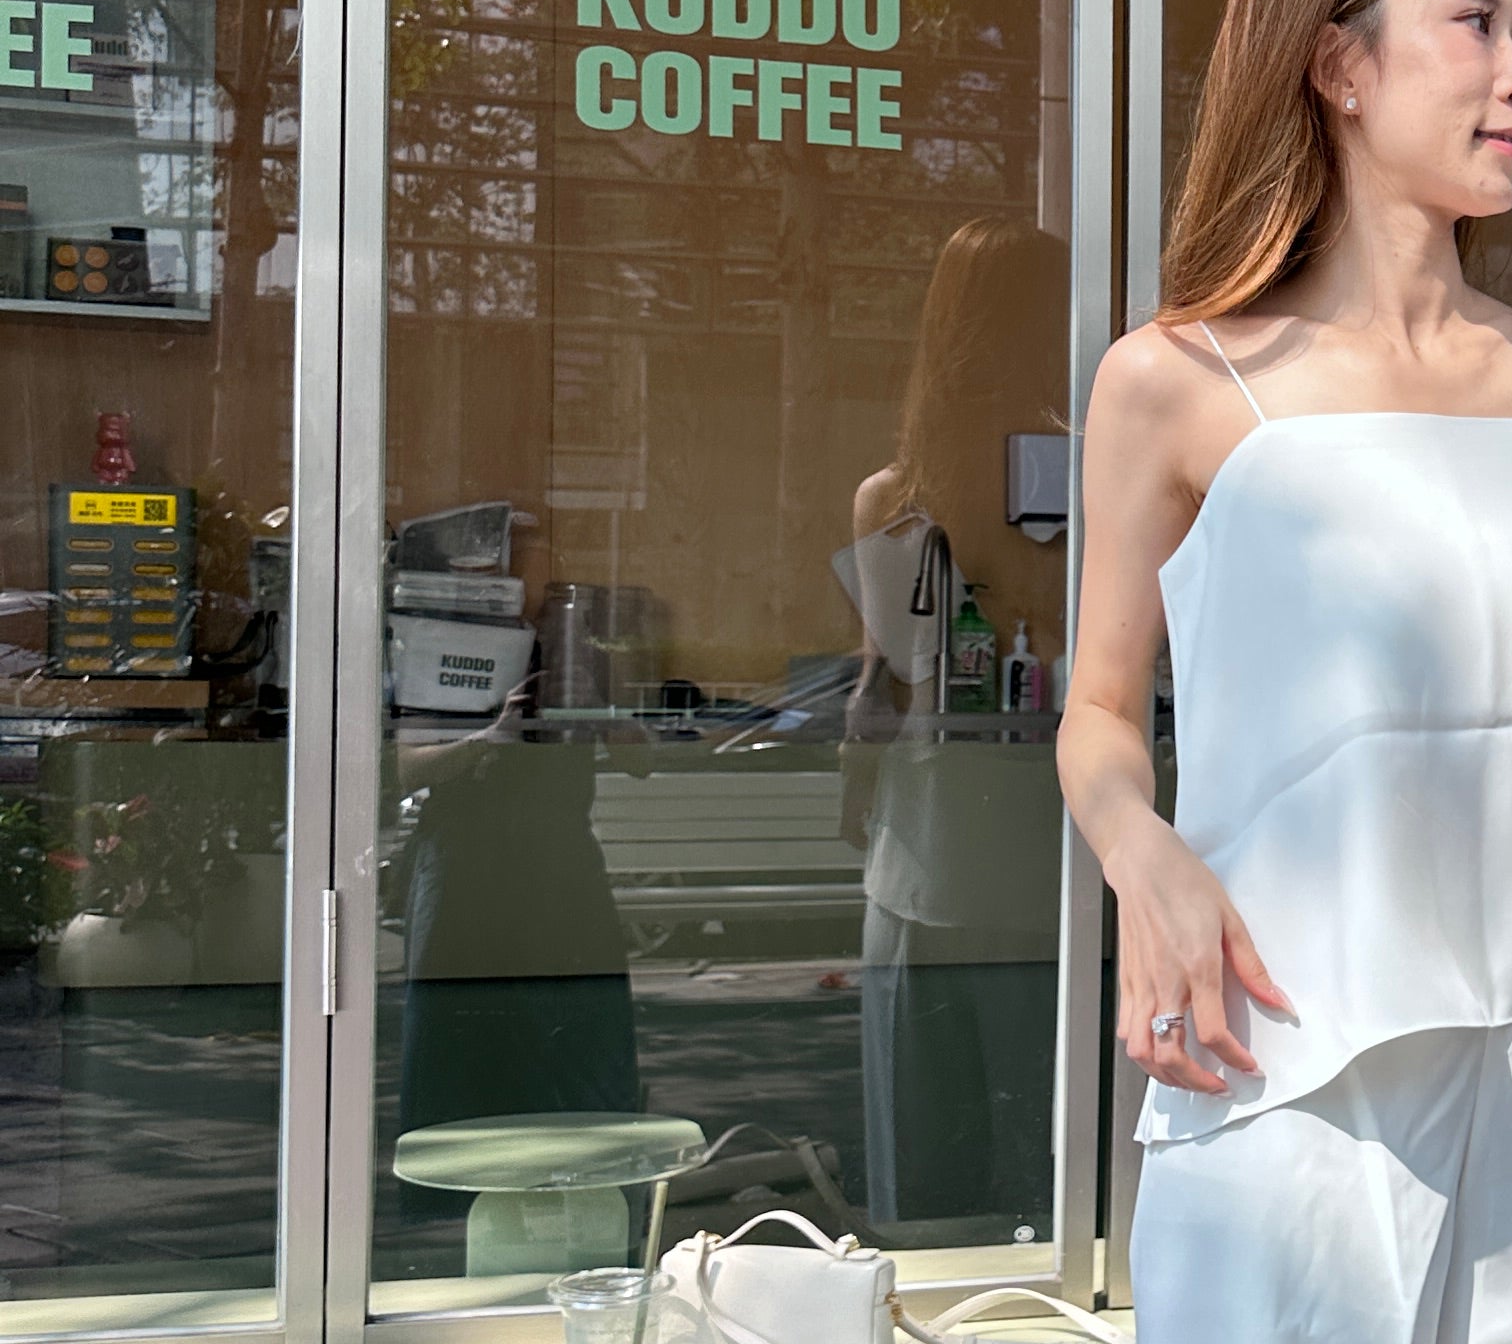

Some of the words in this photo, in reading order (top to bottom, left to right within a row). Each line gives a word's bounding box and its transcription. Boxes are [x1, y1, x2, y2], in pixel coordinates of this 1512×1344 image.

[575, 45, 902, 151] COFFEE
[441, 654, 496, 673] KUDDO
[439, 672, 494, 690] COFFEE
